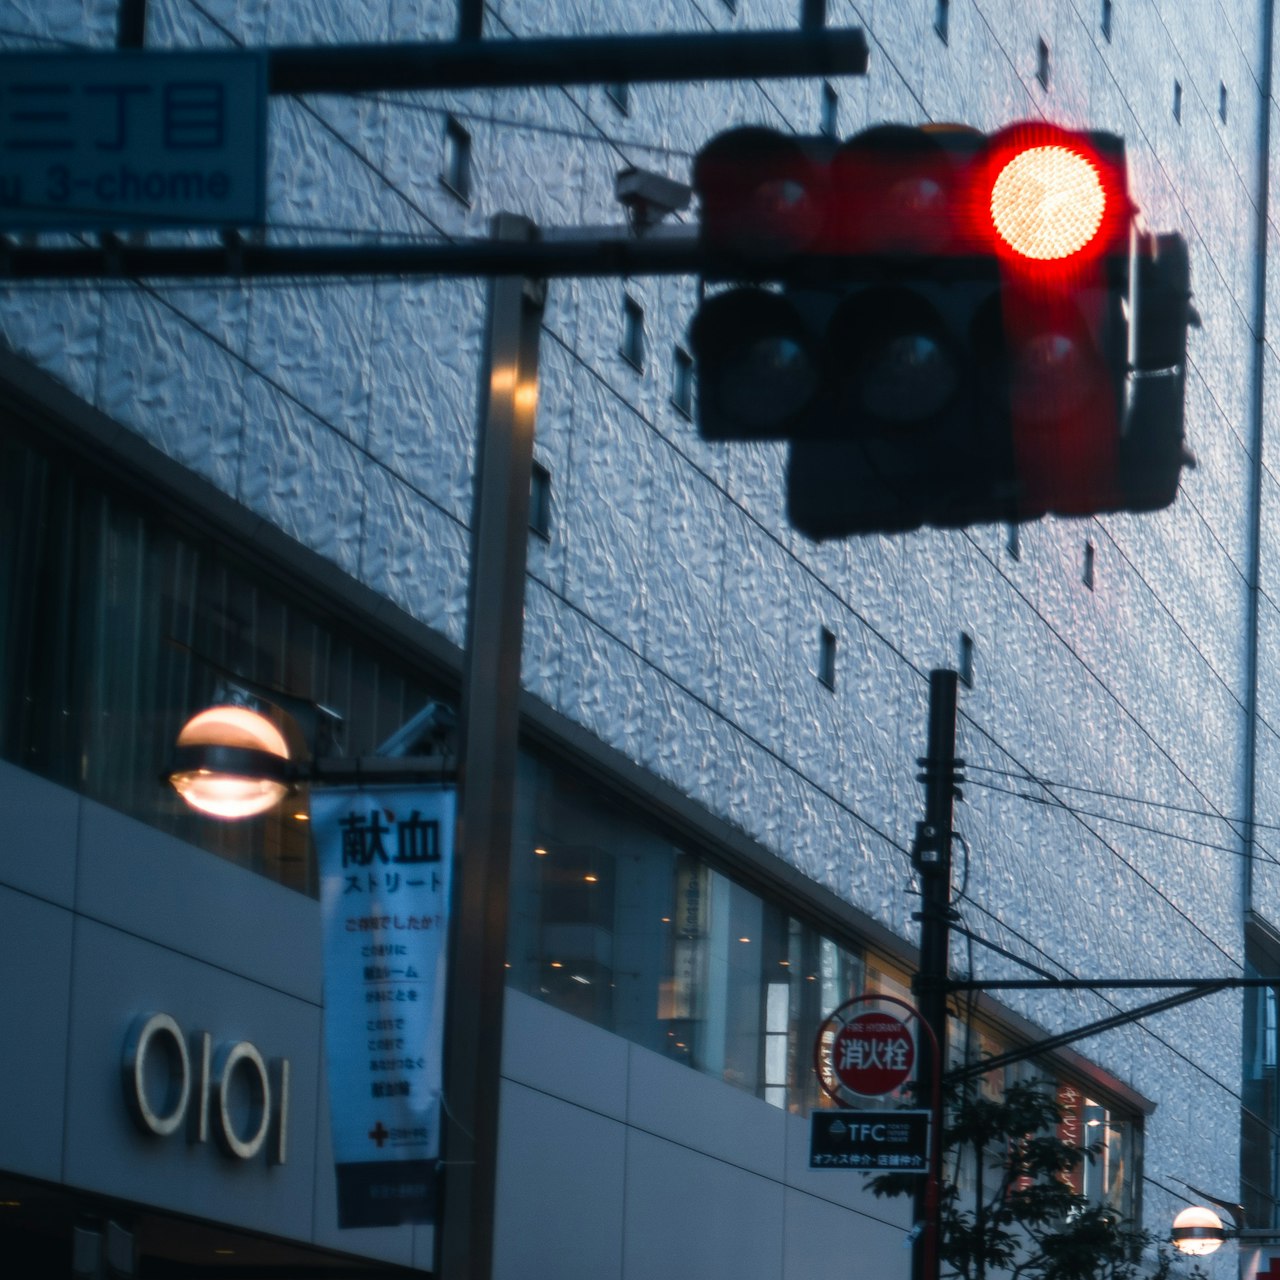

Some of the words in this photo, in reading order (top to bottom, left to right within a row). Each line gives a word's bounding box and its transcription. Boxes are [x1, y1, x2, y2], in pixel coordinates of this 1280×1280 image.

[46, 163, 230, 200] 3-chome
[338, 810, 441, 868] 献血
[343, 871, 443, 894] ストリート
[838, 1037, 910, 1071] 消火栓
[849, 1123, 887, 1142] TFC
